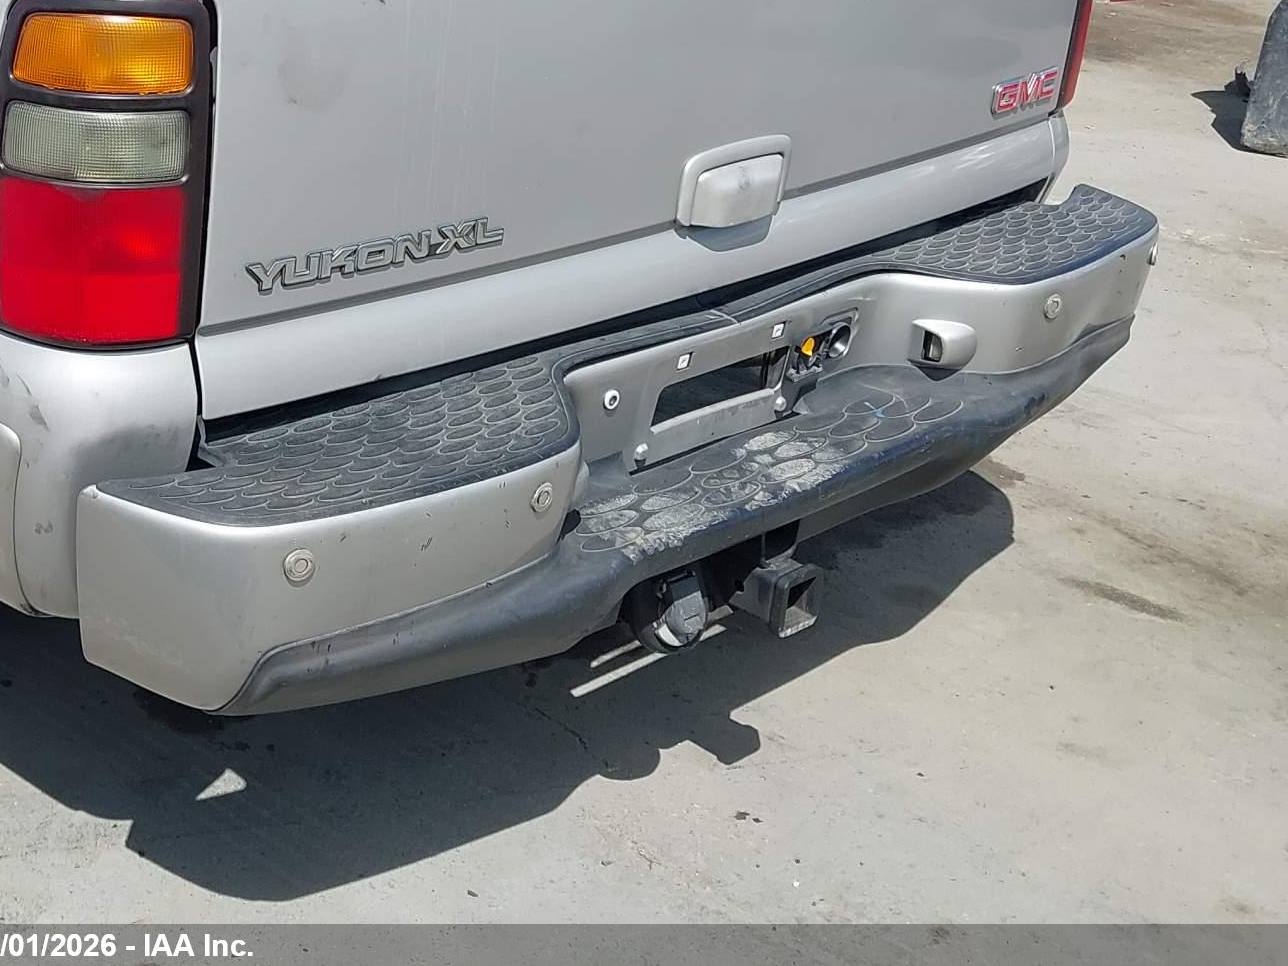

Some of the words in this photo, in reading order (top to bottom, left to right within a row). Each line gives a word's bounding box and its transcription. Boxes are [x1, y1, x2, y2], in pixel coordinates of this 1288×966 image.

[995, 70, 1059, 113] GMC
[245, 229, 432, 292] YUKON
[436, 217, 505, 254] XL
